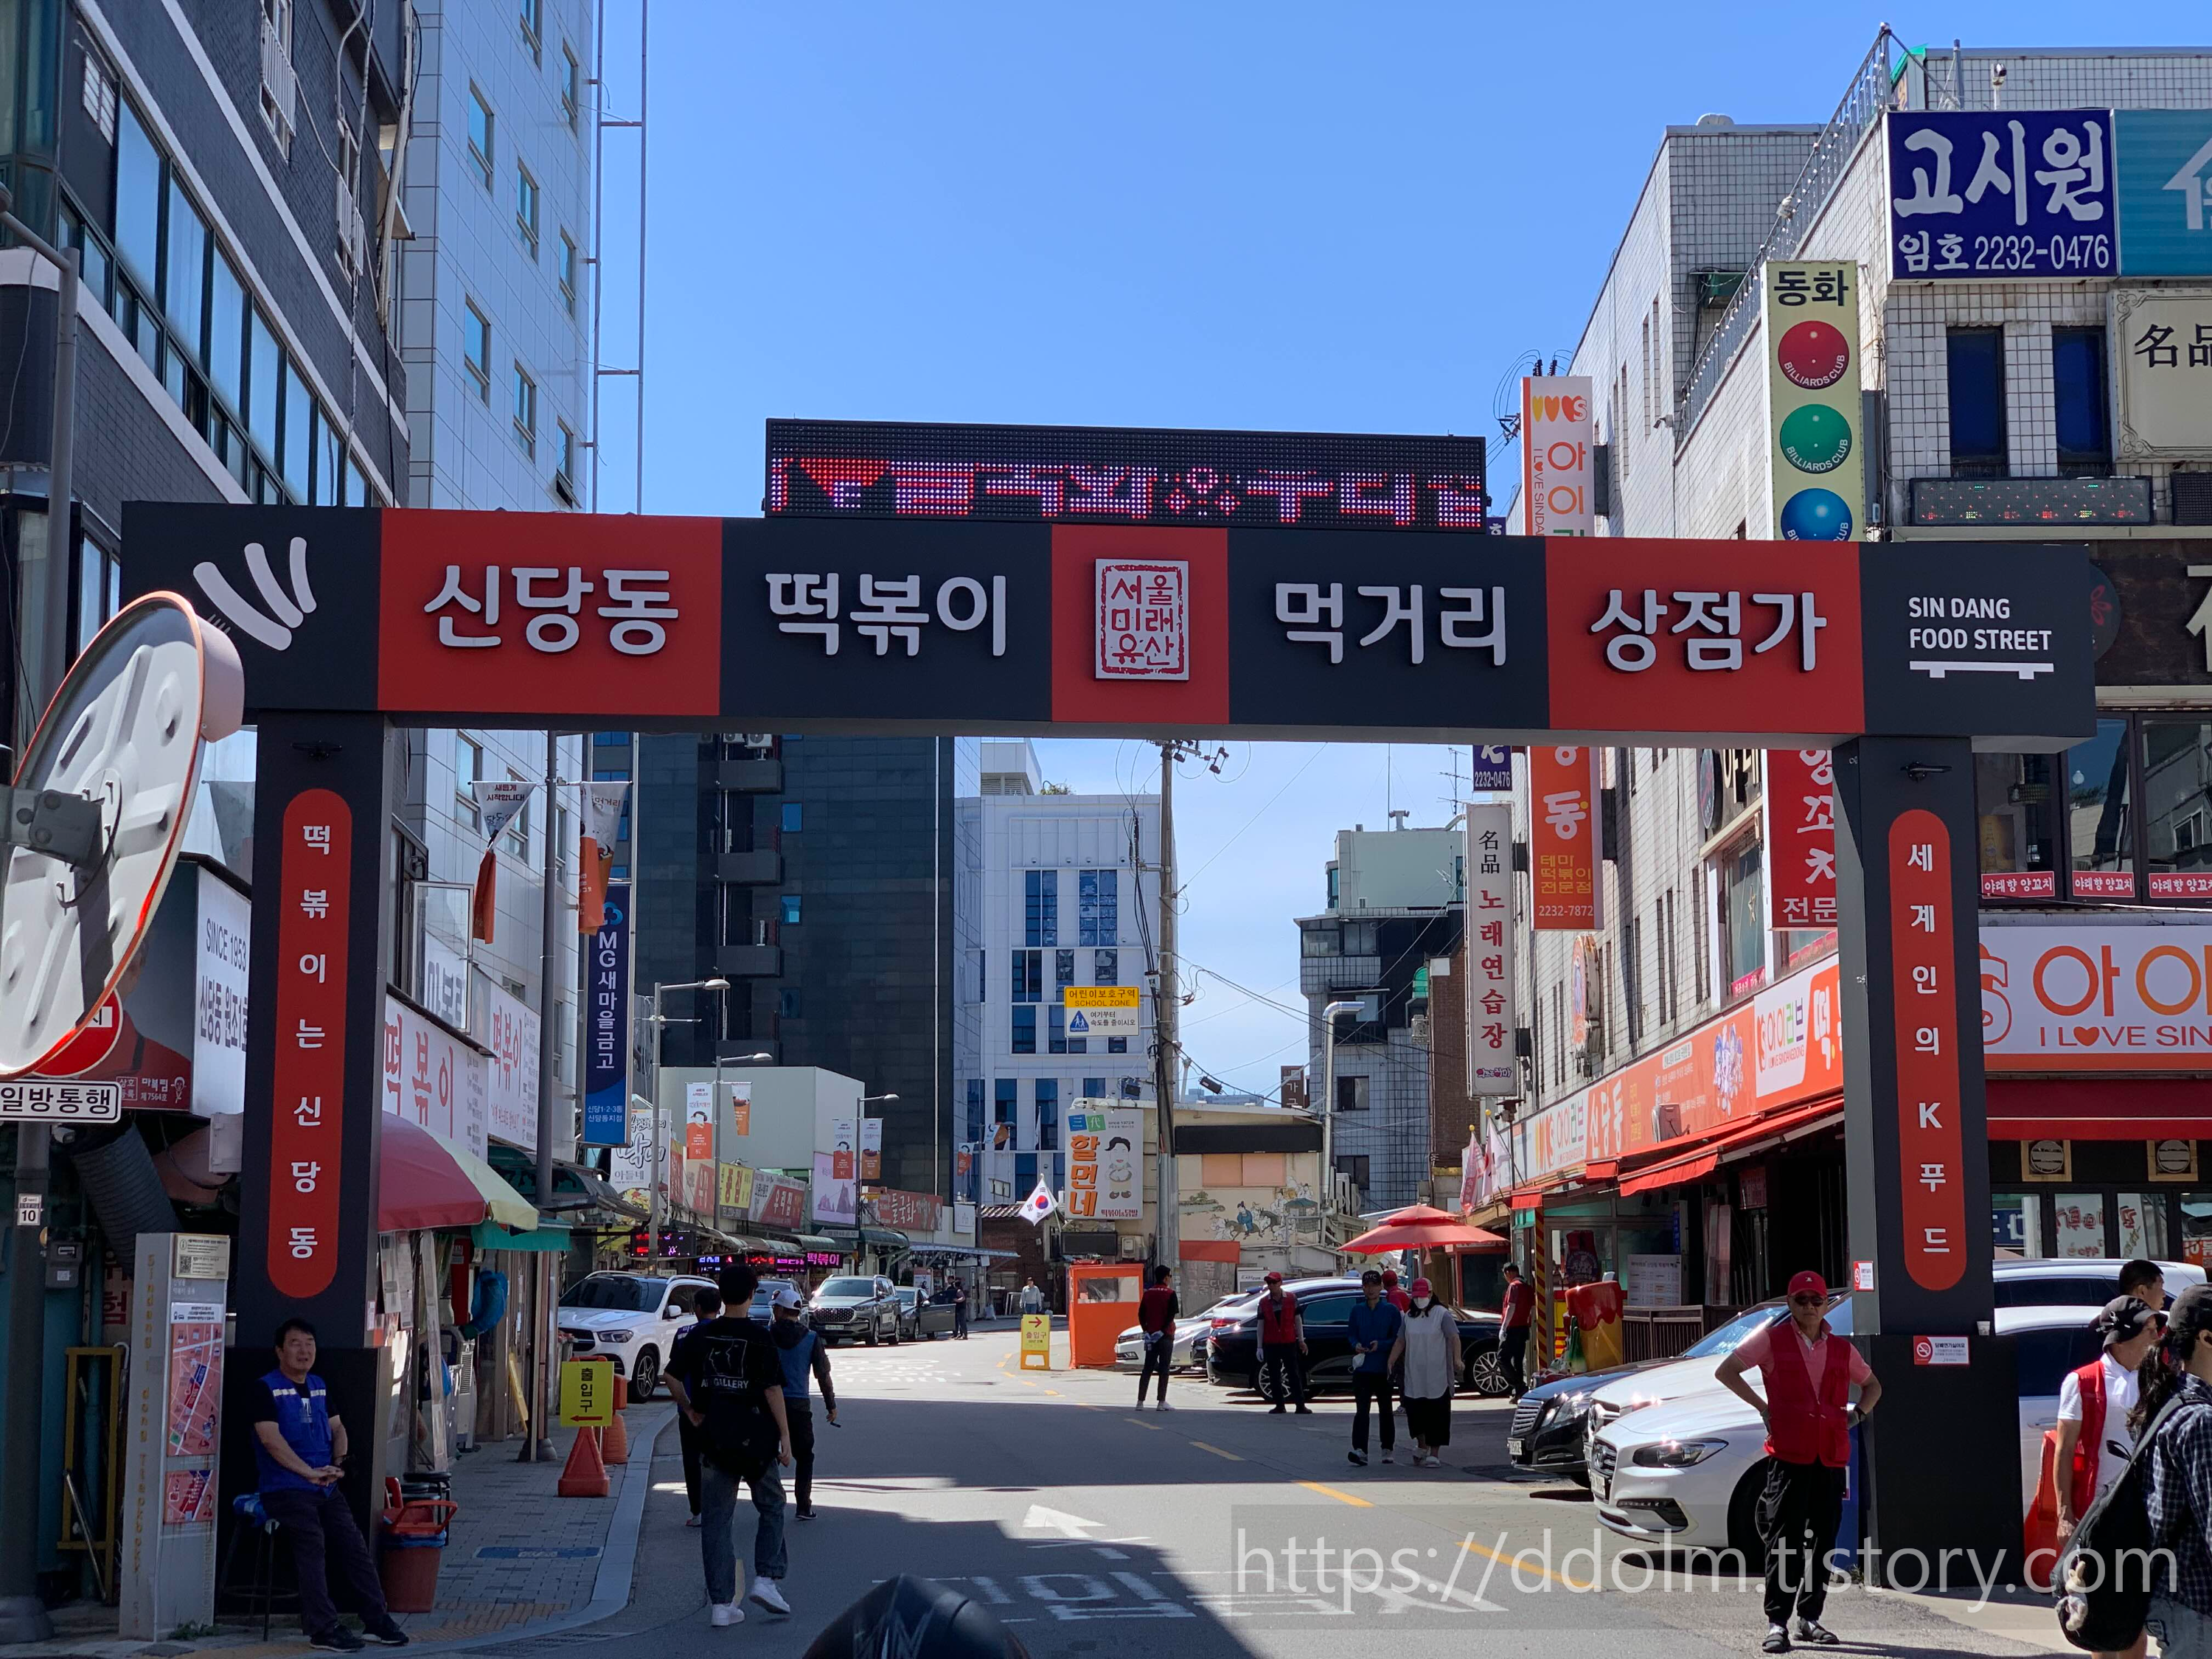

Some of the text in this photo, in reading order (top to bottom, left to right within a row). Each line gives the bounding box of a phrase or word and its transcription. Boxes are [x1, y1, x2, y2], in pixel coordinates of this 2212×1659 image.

[1893, 119, 2104, 226] 고시원
[1898, 230, 2110, 273] 임호 2232-0476
[1773, 270, 1849, 307] 동화
[1784, 354, 1846, 387] BILLIARDS CLUB
[1786, 439, 1848, 471] BILLIARDS CLUB
[1548, 441, 1587, 535] 아이
[1110, 574, 1174, 605] 서울
[423, 565, 1006, 657] 신당동 떡볶이
[1110, 607, 1174, 633] 미래
[1908, 596, 2011, 619] SIN DANG
[1276, 582, 1828, 672] 먹거리 상점가
[1909, 627, 2052, 651] FOOD STREET
[1110, 634, 1175, 667] 유산
[1474, 771, 1511, 787] 2232-0476
[1478, 830, 1500, 874] 名品
[1540, 855, 1574, 867] 테마
[1540, 867, 1592, 880] 떡볶이
[1540, 881, 1592, 894] 전문점
[1538, 905, 1594, 917] 2232-7872
[206, 917, 246, 973] SINCE 1953
[1478, 889, 1508, 1049] 노래연습장
[200, 975, 223, 1046] 신당동
[1069, 989, 1135, 999] 어린이보호구역
[288, 824, 331, 1259] 떡볶이는 신당동
[493, 1004, 522, 1098] 떡볶이
[1907, 844, 1951, 1253] 세계인의 K푸드
[385, 1013, 454, 1140] 떡볶이
[1, 1086, 111, 1114] 일방통행
[614, 1169, 644, 1180] 아들네
[21, 1210, 35, 1222] 10
[891, 1192, 917, 1224] 들국화
[580, 1368, 594, 1413] 출입구
[713, 1379, 749, 1389] GALLERY
